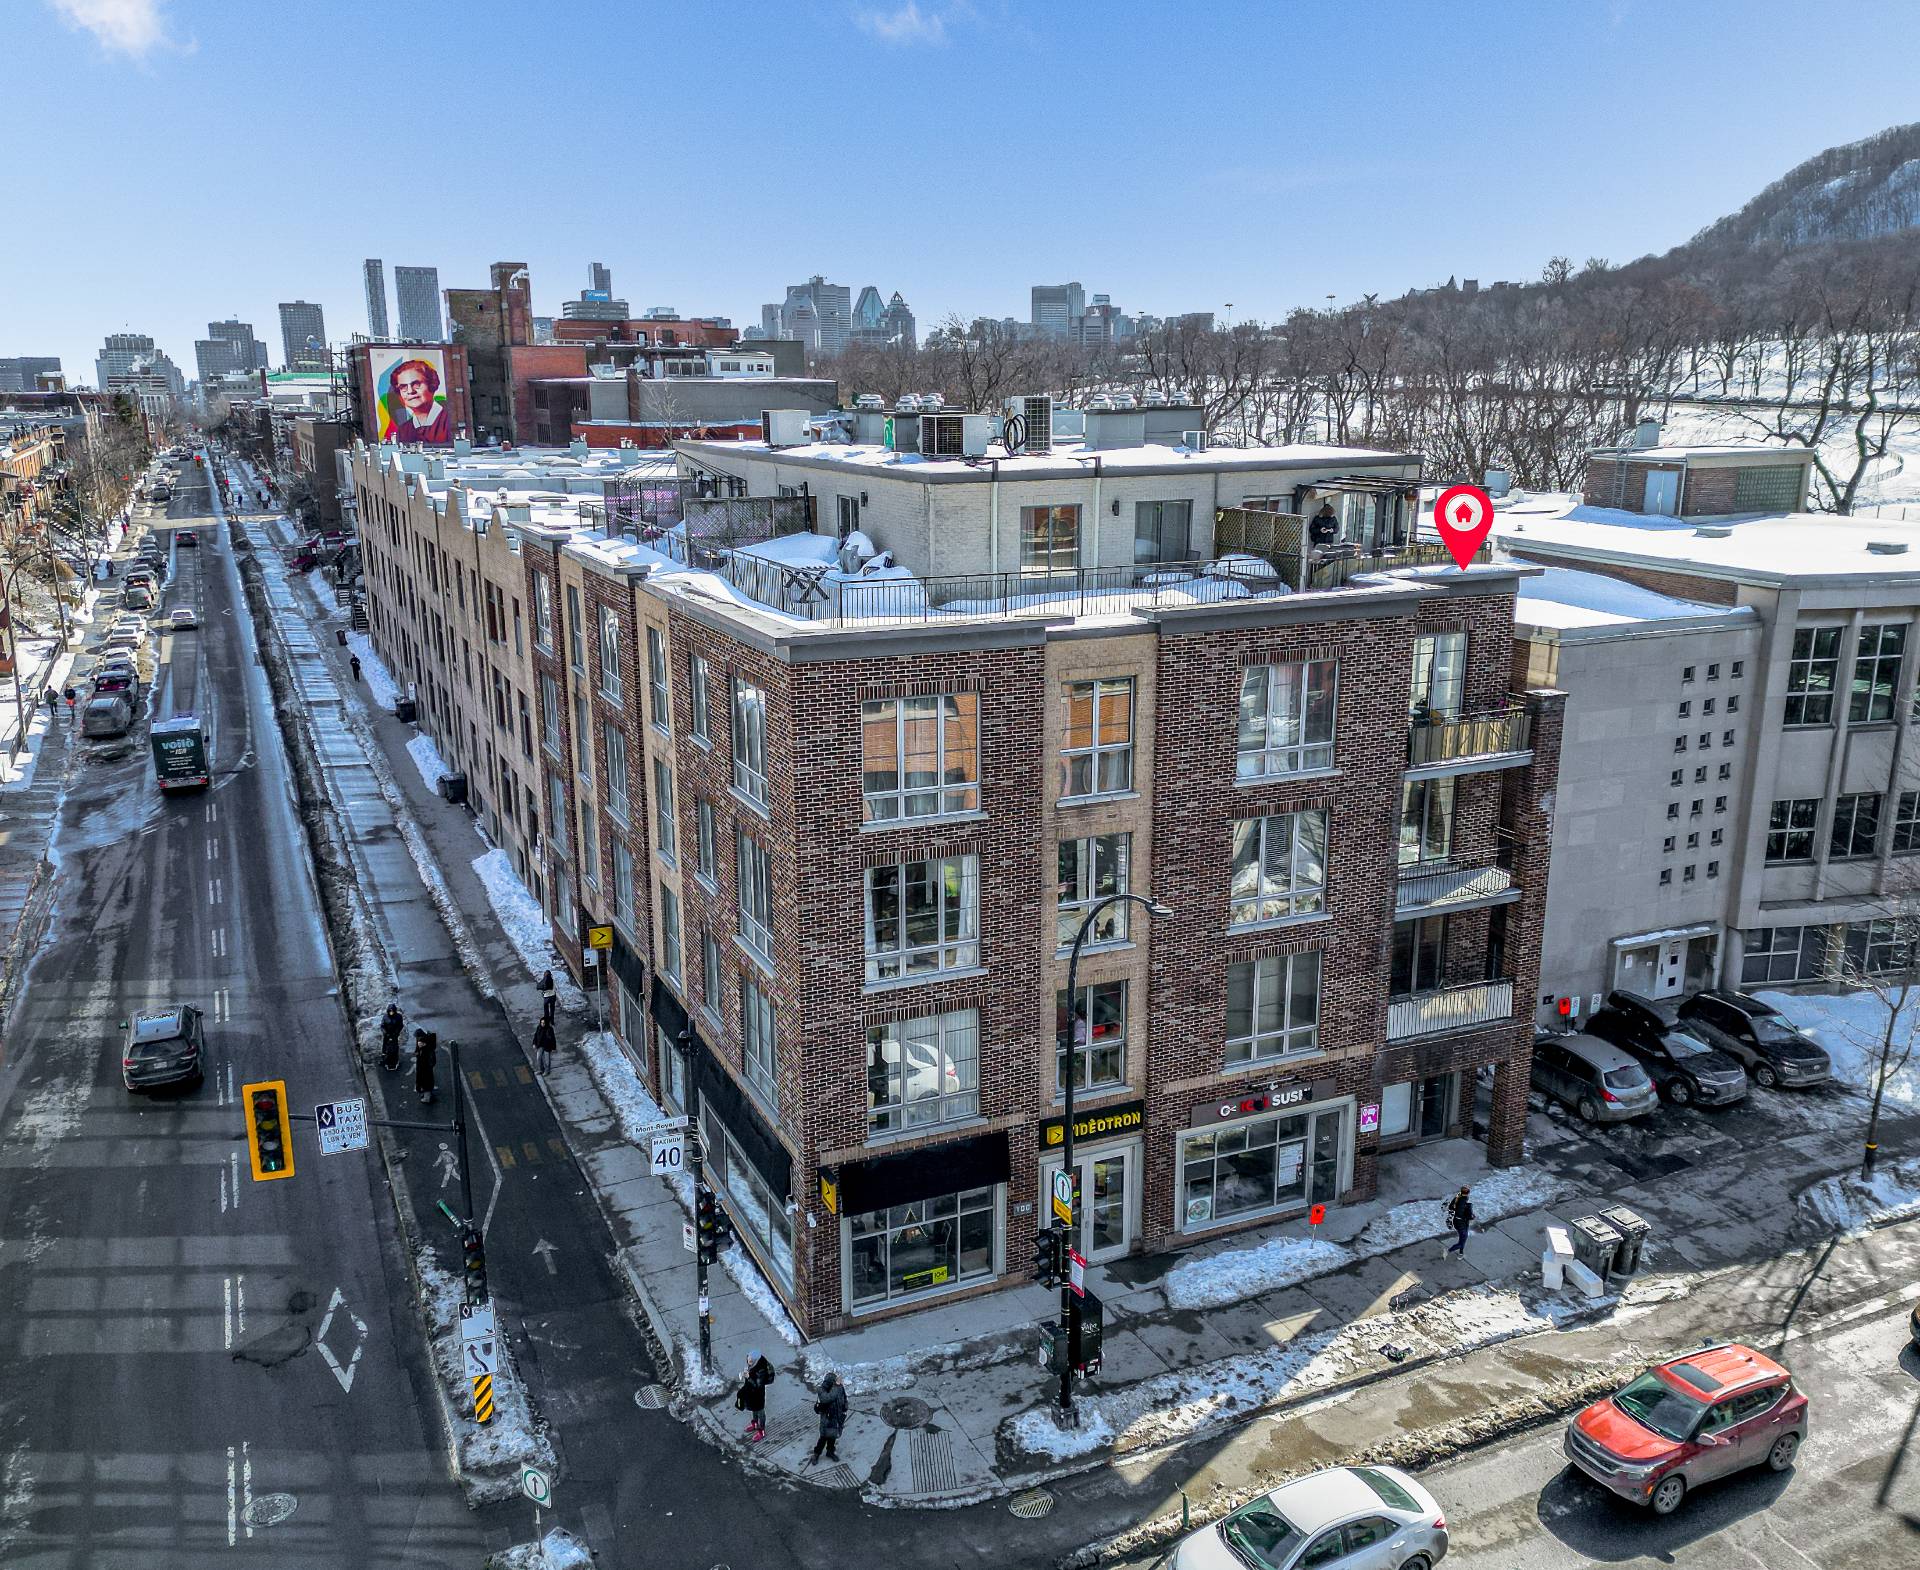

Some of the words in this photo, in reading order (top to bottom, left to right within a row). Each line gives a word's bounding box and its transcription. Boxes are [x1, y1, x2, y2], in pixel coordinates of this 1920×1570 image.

[336, 1104, 361, 1114] BUS
[338, 1114, 362, 1124] TAXI
[1072, 1111, 1141, 1137] IDÉOTRON
[635, 1121, 675, 1134] Mont-Royal
[349, 1132, 361, 1140] VEN
[653, 1136, 681, 1146] MAXIMUM
[655, 1146, 681, 1168] 40
